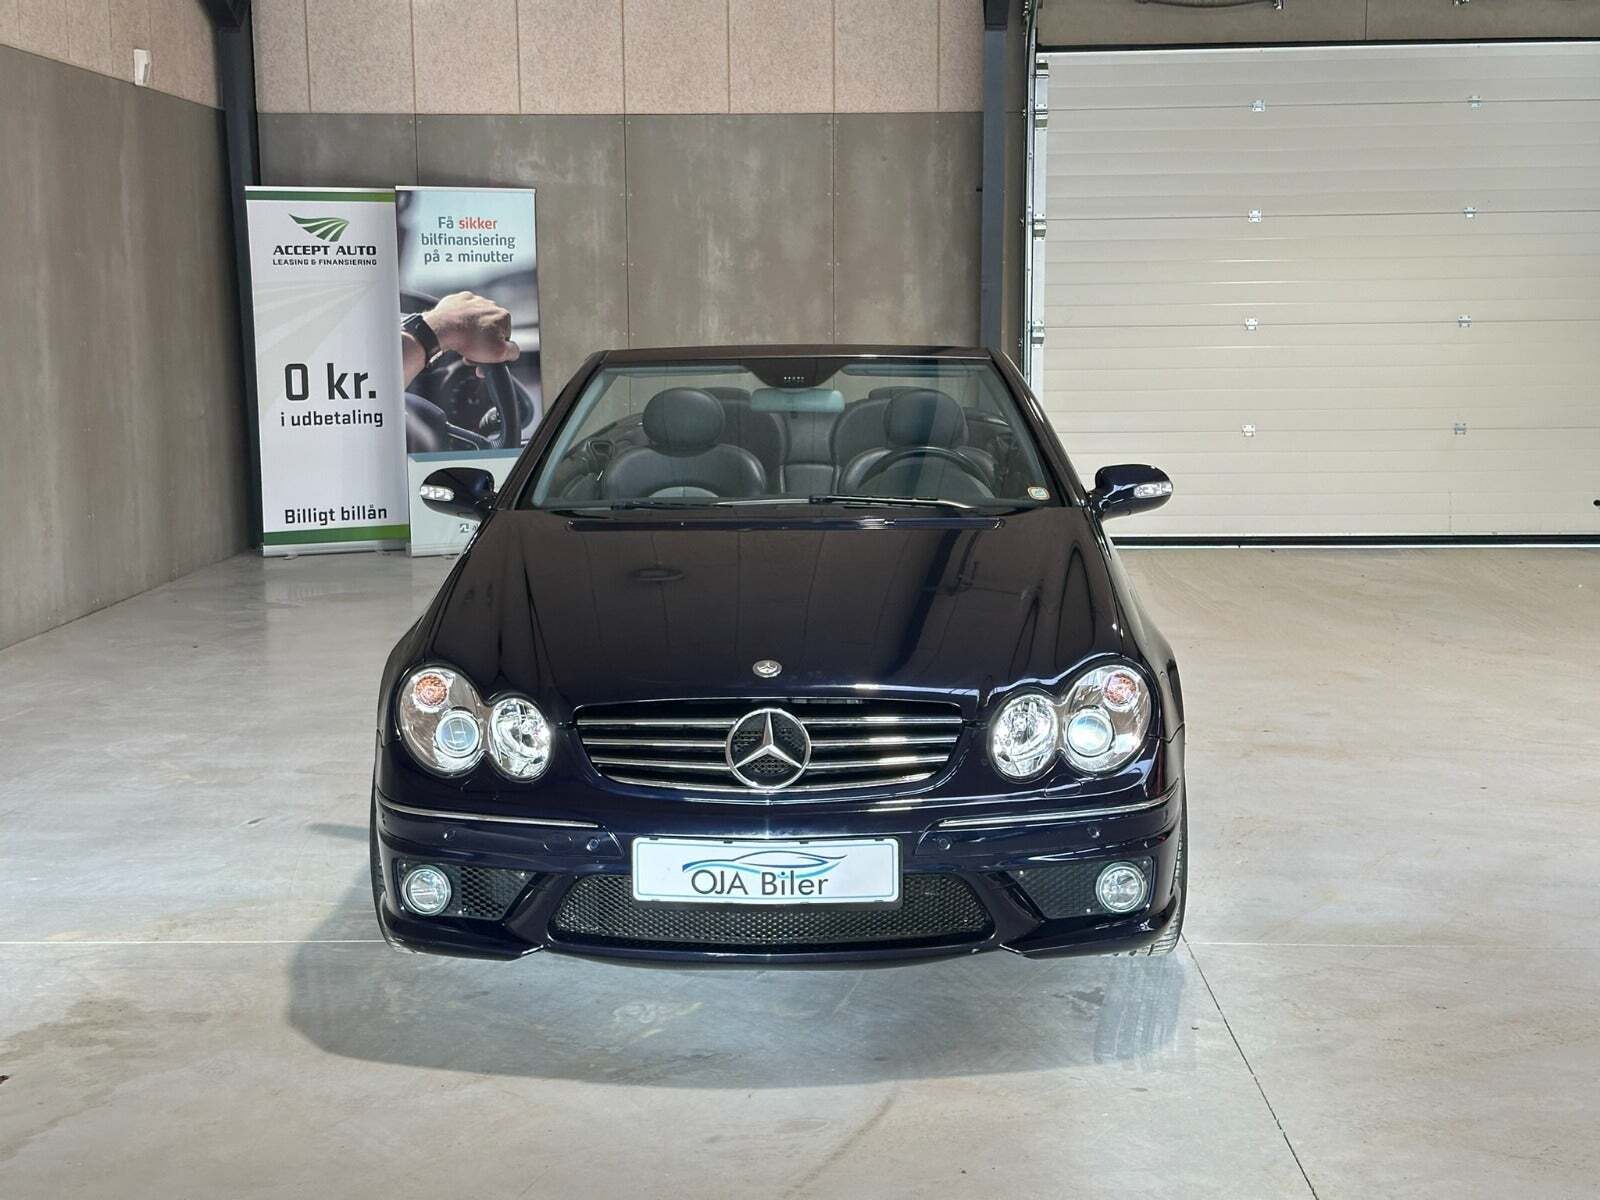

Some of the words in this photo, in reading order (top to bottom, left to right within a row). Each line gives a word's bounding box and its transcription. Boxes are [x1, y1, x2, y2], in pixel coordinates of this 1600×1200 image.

[438, 216, 454, 230] Få
[458, 216, 498, 230] sikker
[273, 245, 331, 256] ACCEPT
[336, 245, 377, 256] AUTO
[421, 233, 516, 251] bilfinansiering
[424, 249, 440, 265] på
[445, 253, 453, 263] 2
[457, 250, 514, 263] minutter
[284, 363, 309, 402] 0
[327, 362, 377, 401] kr.
[280, 411, 285, 427] i
[291, 409, 384, 428] udbetaling
[284, 507, 335, 526] Billigt
[340, 504, 388, 521] billån
[691, 870, 749, 895] OJA
[761, 871, 829, 895] Biler
